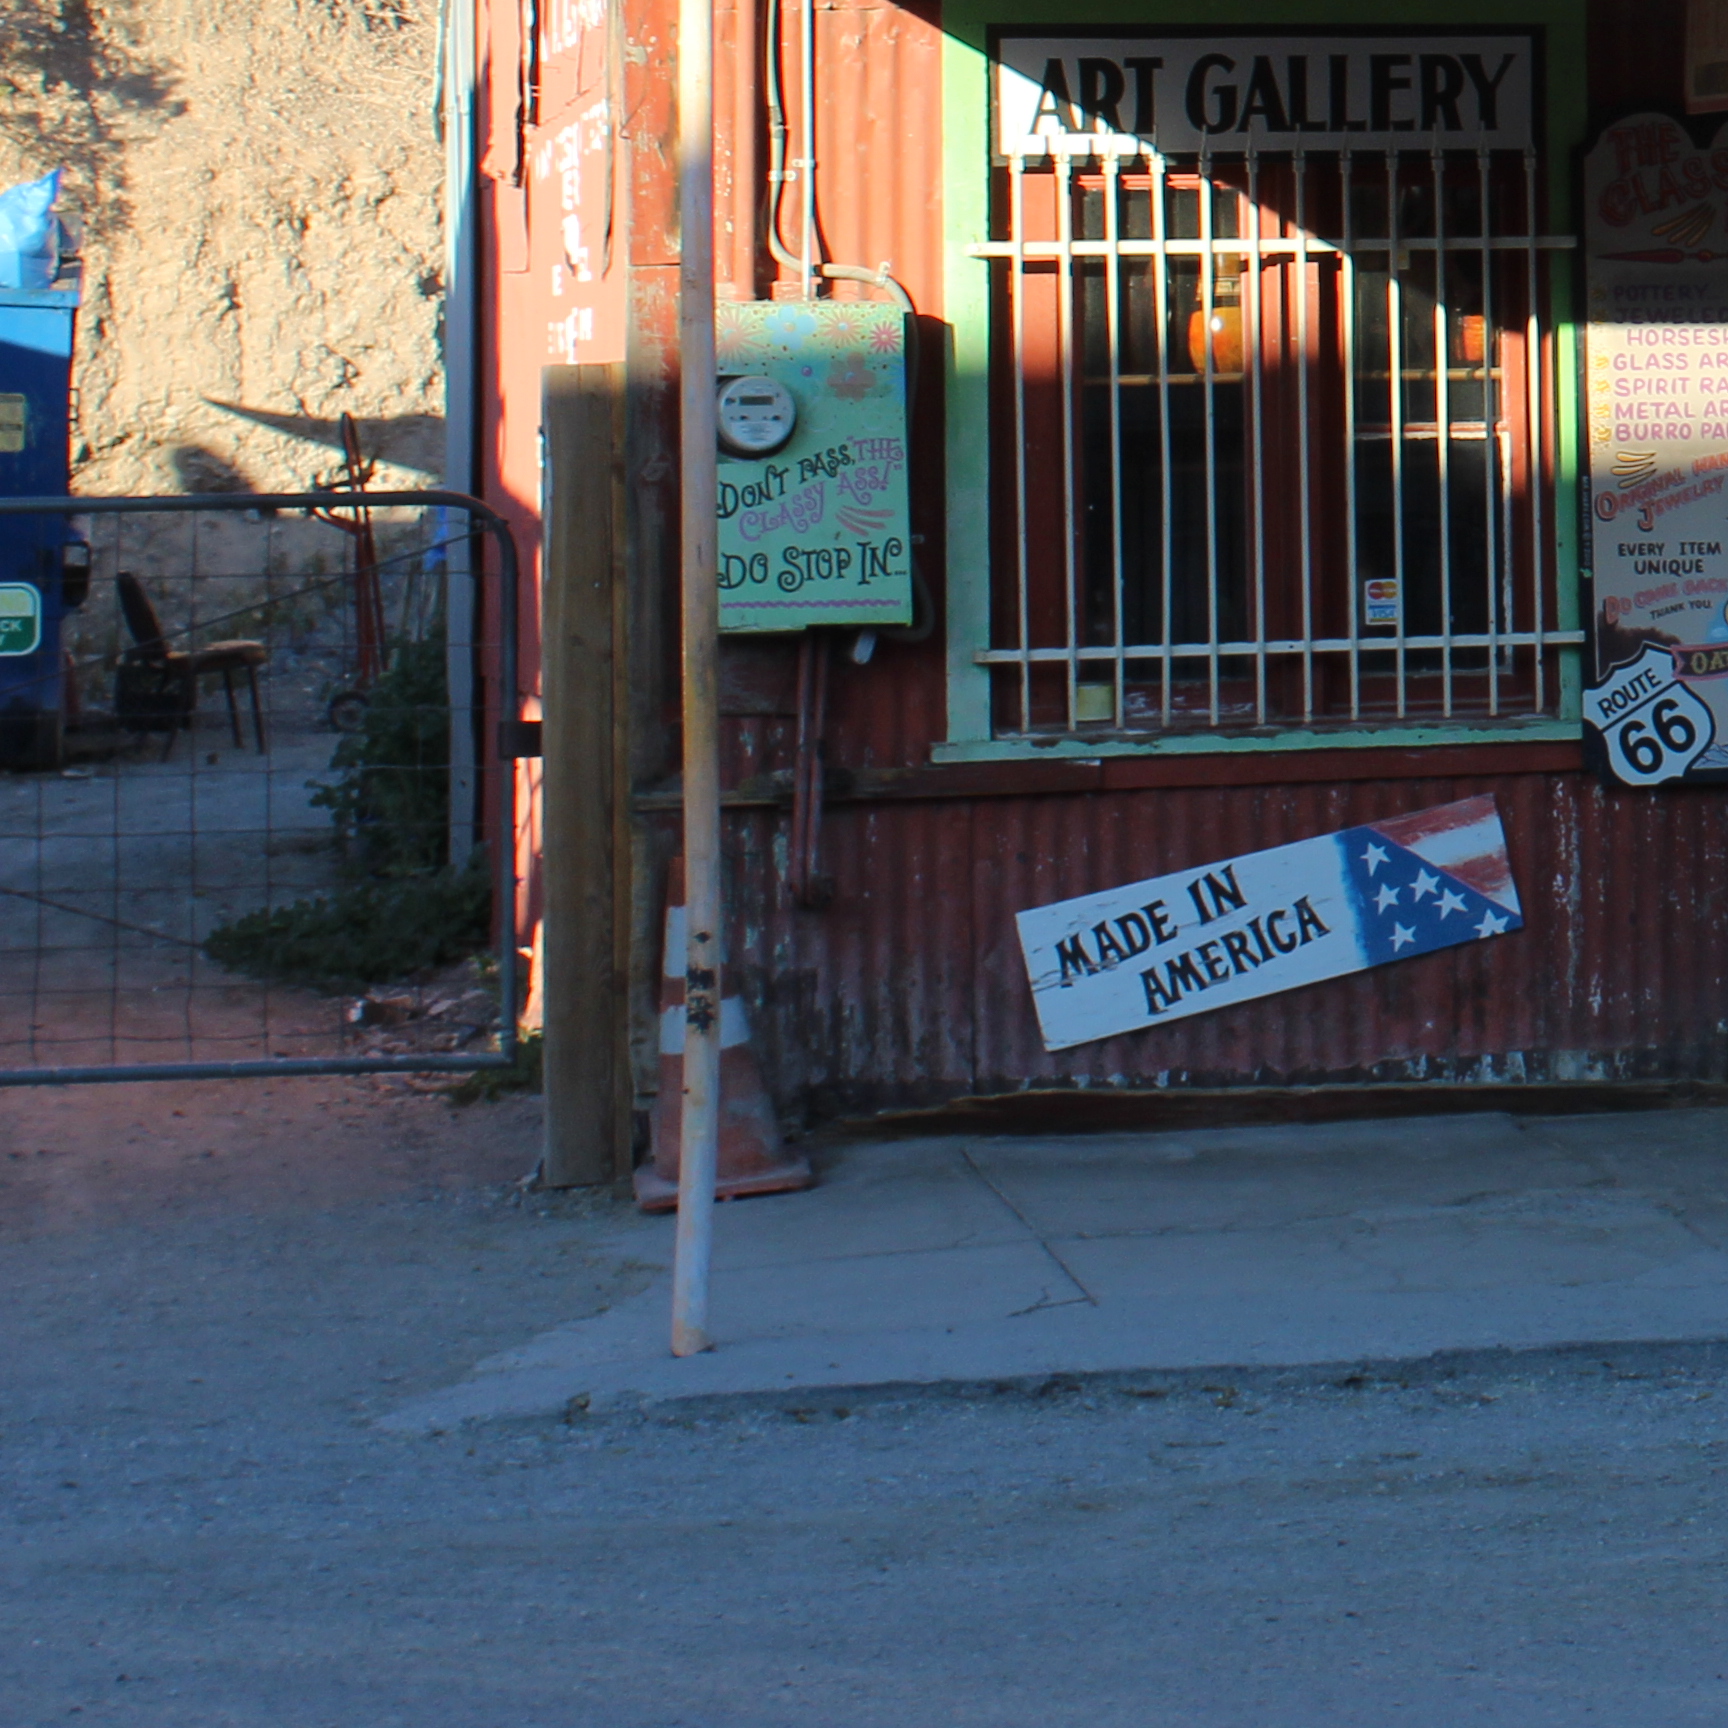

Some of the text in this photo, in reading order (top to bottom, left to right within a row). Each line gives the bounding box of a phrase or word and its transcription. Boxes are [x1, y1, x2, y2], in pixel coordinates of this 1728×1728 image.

[1030, 52, 1517, 135] ART GALLERY
[1607, 122, 1681, 177] THE
[1613, 353, 1688, 370] GLASS
[1613, 377, 1691, 397] SPIRIT
[1615, 402, 1696, 420] METAL
[1615, 422, 1692, 442] BURRO
[739, 481, 825, 542] CLASSY
[1637, 475, 1726, 532] JEWELRY
[716, 553, 769, 589] DO
[777, 546, 852, 593] STOP
[1618, 541, 1721, 557] EVERY ITEM
[1634, 559, 1704, 576] UNIQUE
[1604, 578, 1728, 623] DO COME BACK
[1649, 602, 1685, 620] THANK
[1597, 667, 1662, 719] ROUTE
[1619, 698, 1696, 775] 66
[1054, 863, 1248, 989] MADE IN
[1139, 895, 1332, 1016] AMERICA
